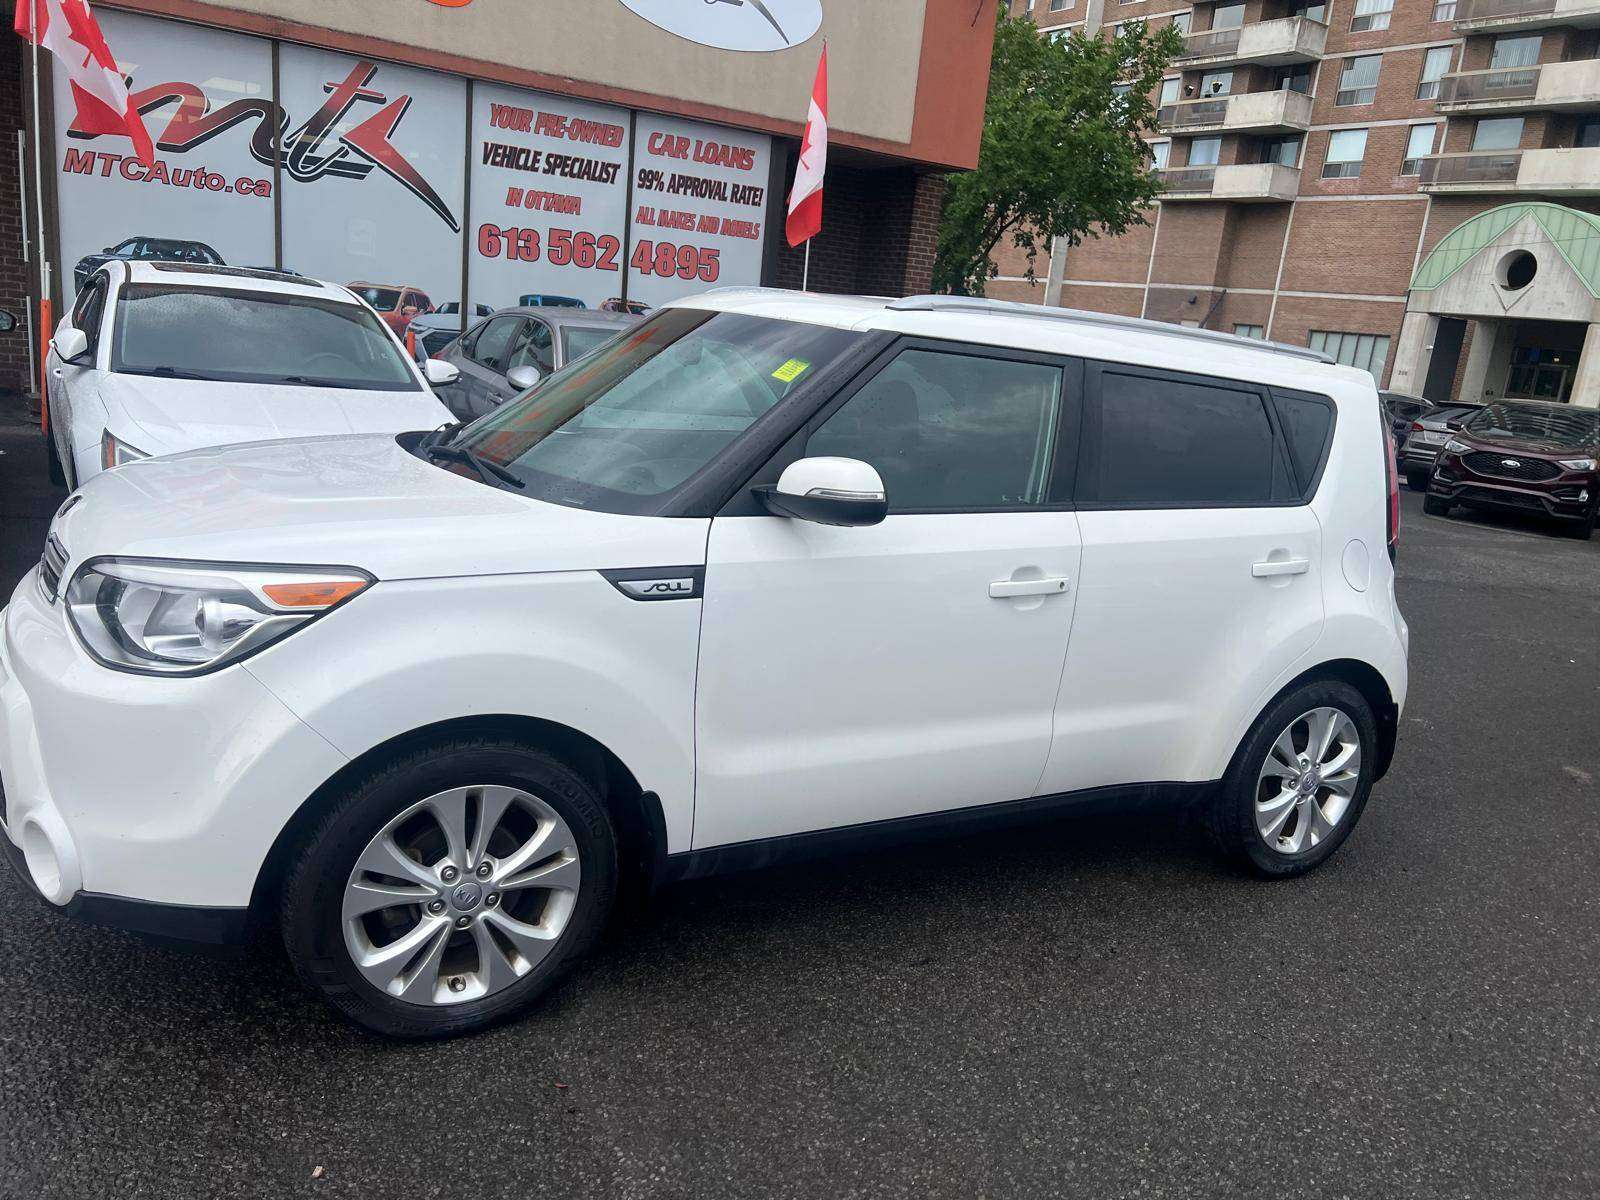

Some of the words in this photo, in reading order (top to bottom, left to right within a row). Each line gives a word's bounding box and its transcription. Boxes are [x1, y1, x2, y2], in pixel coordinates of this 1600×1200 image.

[489, 102, 533, 133] YOUR
[533, 111, 625, 148] PRE-OWNED
[482, 141, 543, 172] VEHICLE
[542, 152, 622, 185] SPECIALIST
[647, 131, 691, 160] CAR
[692, 139, 756, 170] LOANS
[62, 147, 272, 197] MTCAuto.ca
[637, 167, 665, 192] 99%
[666, 173, 728, 203] APPROVAL
[730, 182, 764, 207] RATE!
[505, 186, 524, 207] IN
[524, 189, 582, 215] OTTAWA
[635, 205, 656, 226] ALL
[656, 208, 697, 231] MAKES
[696, 214, 720, 234] AND
[719, 217, 761, 240] MODELS
[478, 223, 541, 262] 613
[547, 227, 621, 271] 562
[630, 239, 720, 282] 4895
